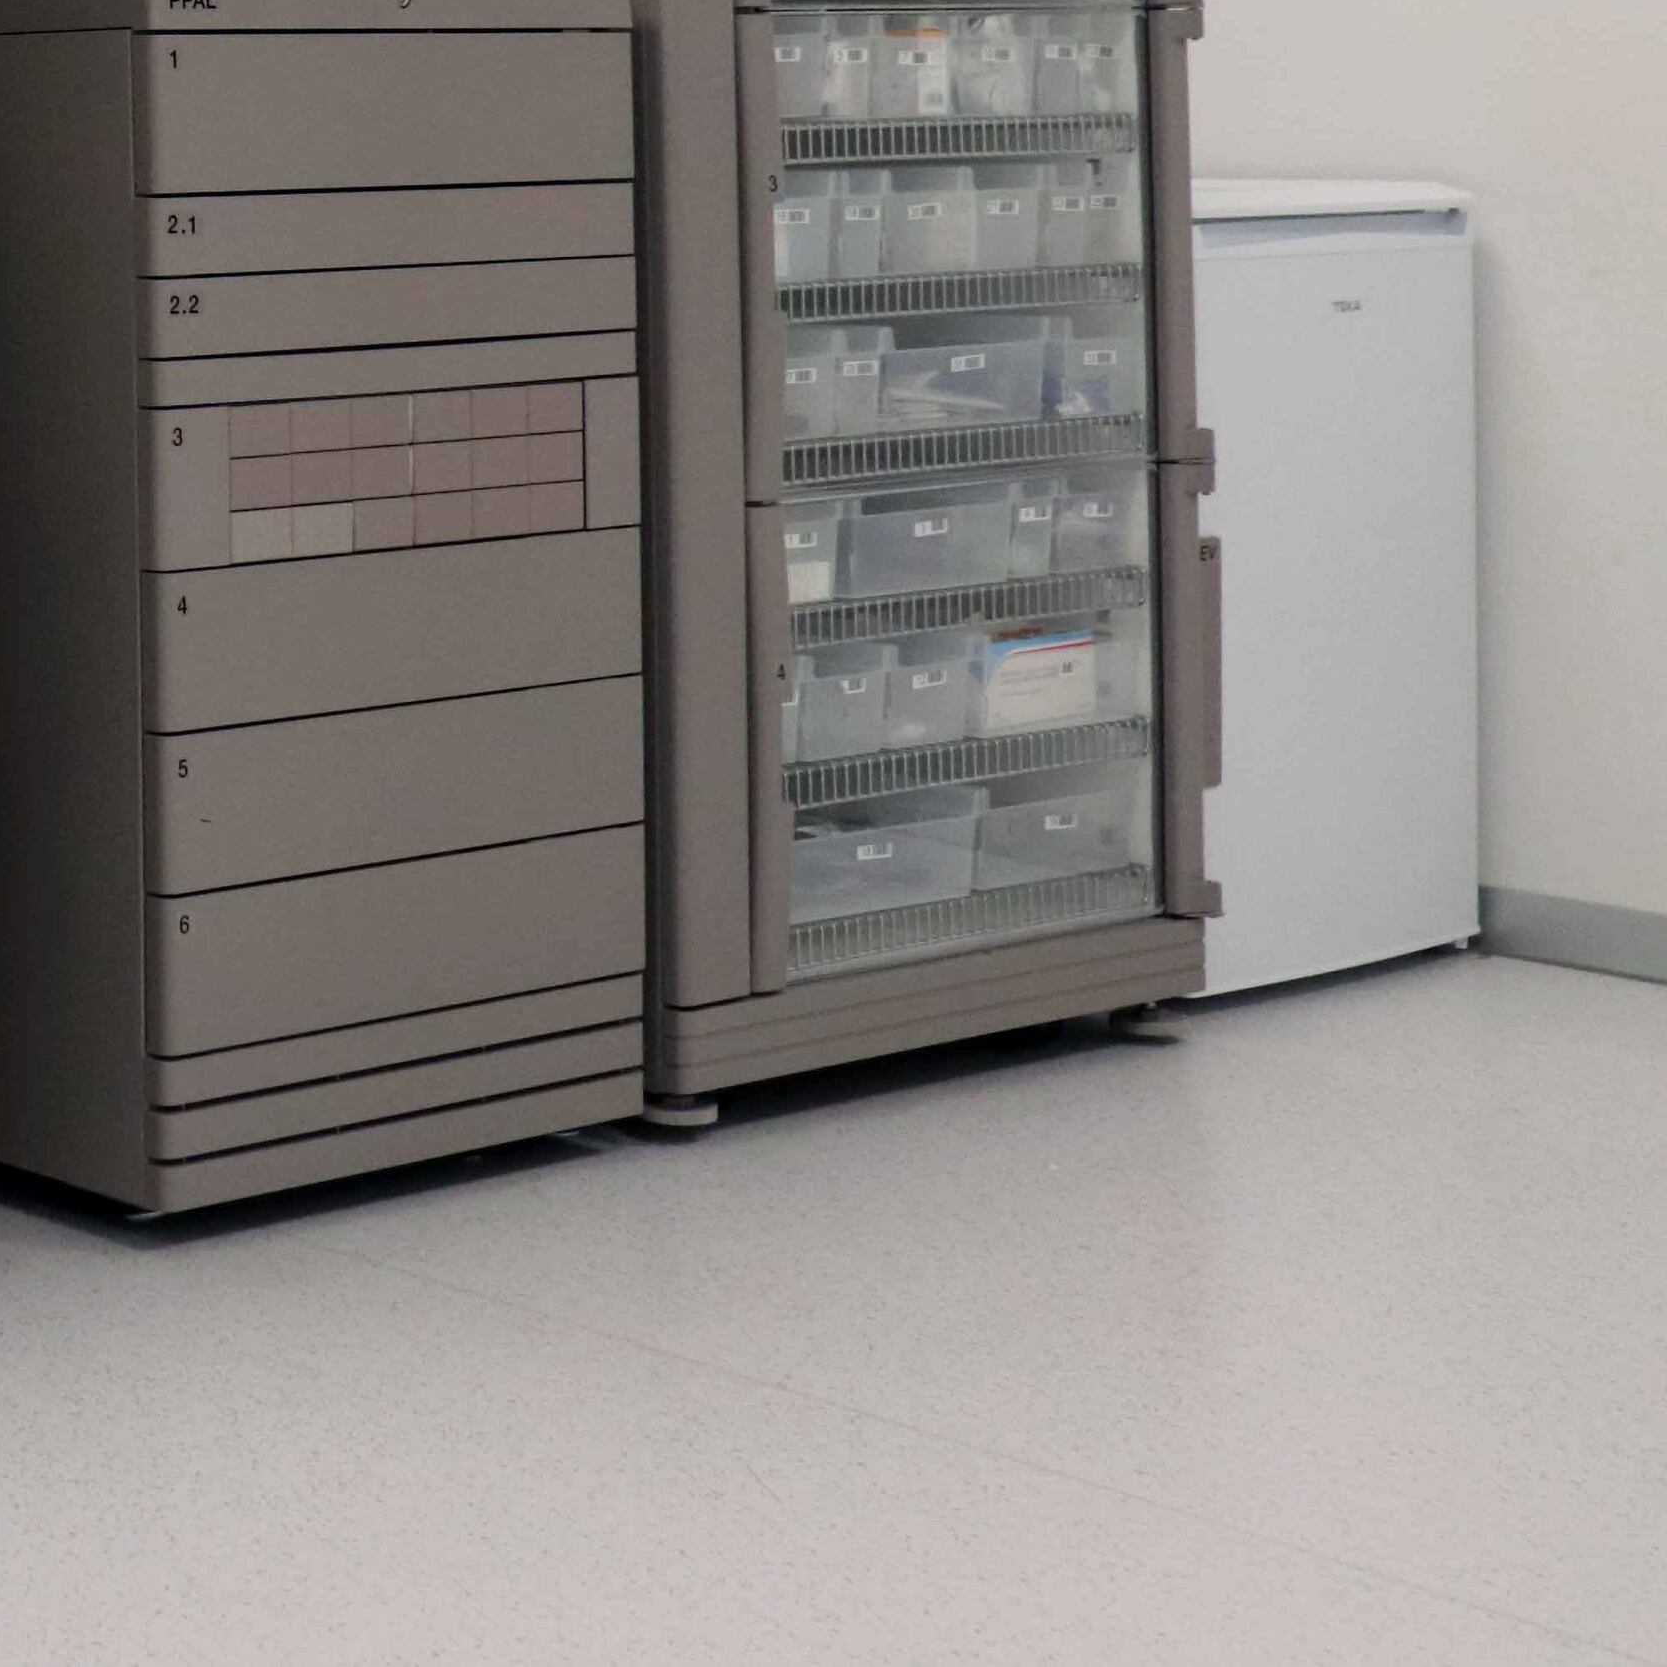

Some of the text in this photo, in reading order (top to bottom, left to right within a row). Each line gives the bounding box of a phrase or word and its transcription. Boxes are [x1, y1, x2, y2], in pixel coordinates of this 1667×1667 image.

[169, 50, 178, 69] 1
[769, 175, 778, 193] 3
[168, 215, 197, 235] 2.1
[170, 294, 199, 315] 2.2
[172, 427, 183, 447] 3
[177, 595, 188, 615] 4
[776, 664, 787, 681] 4
[178, 759, 188, 779] 5
[179, 914, 190, 934] 6
